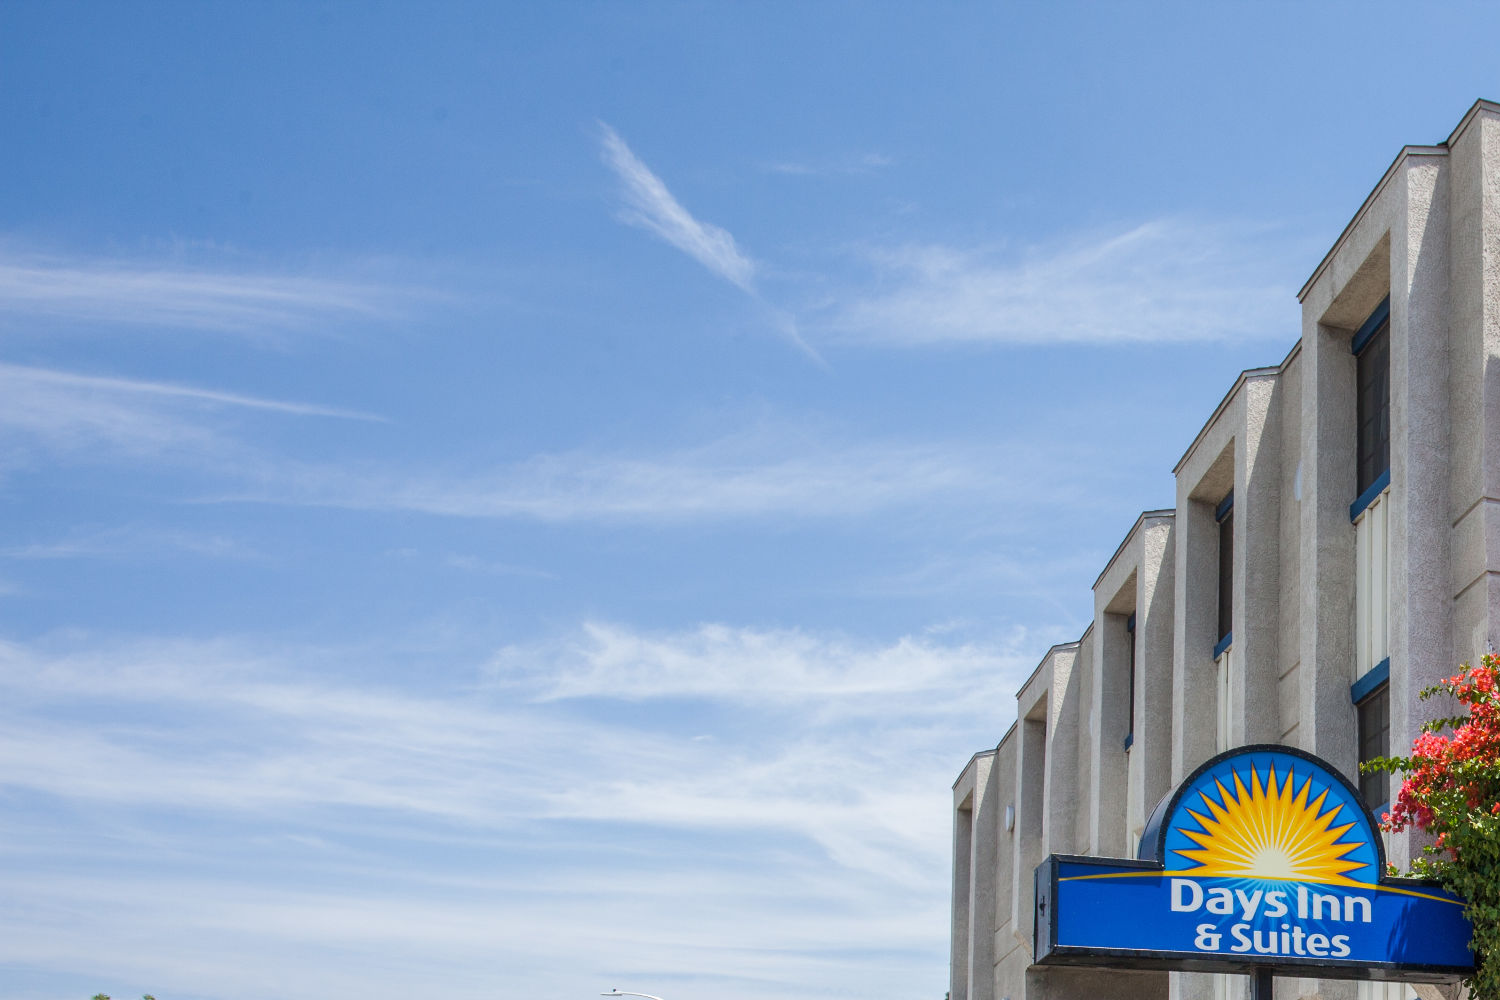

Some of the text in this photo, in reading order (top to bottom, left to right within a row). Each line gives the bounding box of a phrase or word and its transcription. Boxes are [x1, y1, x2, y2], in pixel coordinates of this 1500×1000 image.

[1170, 878, 1372, 923] Days Inn
[1194, 923, 1351, 957] & Suites
